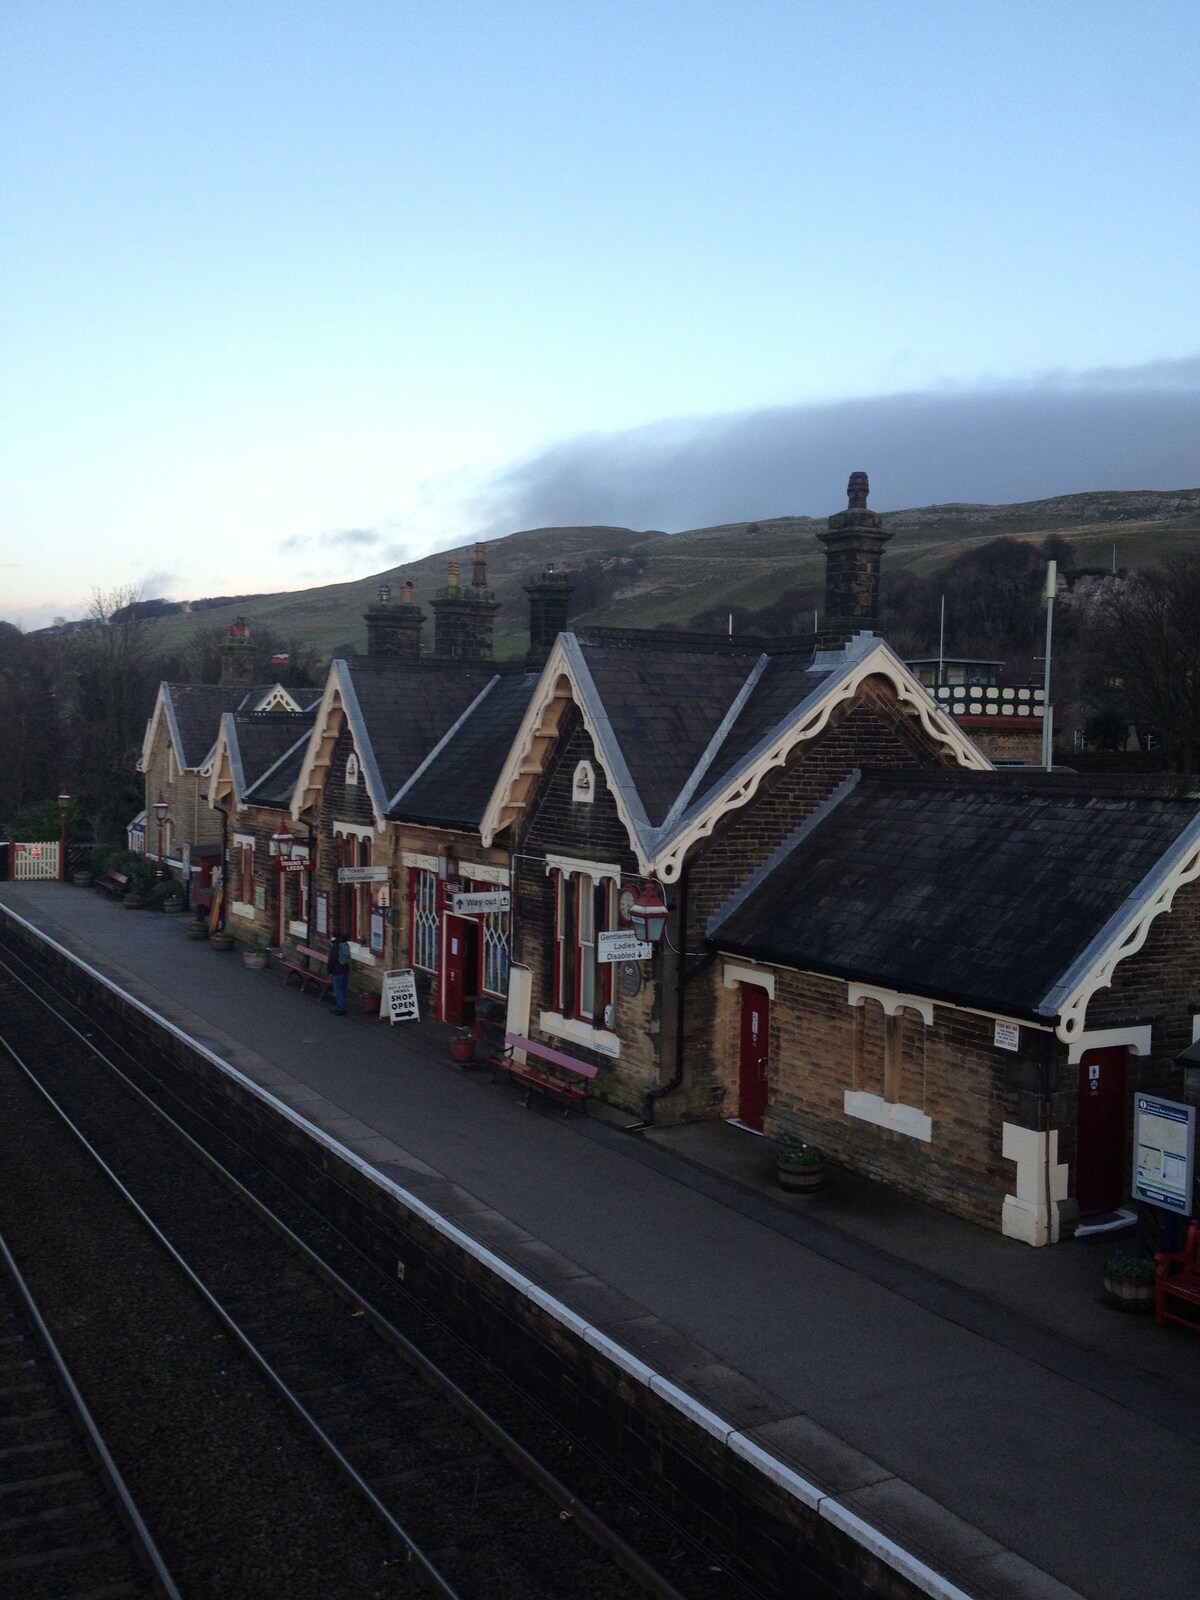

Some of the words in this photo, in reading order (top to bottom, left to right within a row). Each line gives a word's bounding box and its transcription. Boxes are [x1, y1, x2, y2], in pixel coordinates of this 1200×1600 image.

[466, 898, 482, 907] Way
[606, 951, 636, 960] Disabled
[391, 993, 413, 1002] SHOP
[391, 1001, 415, 1010] OPEN
